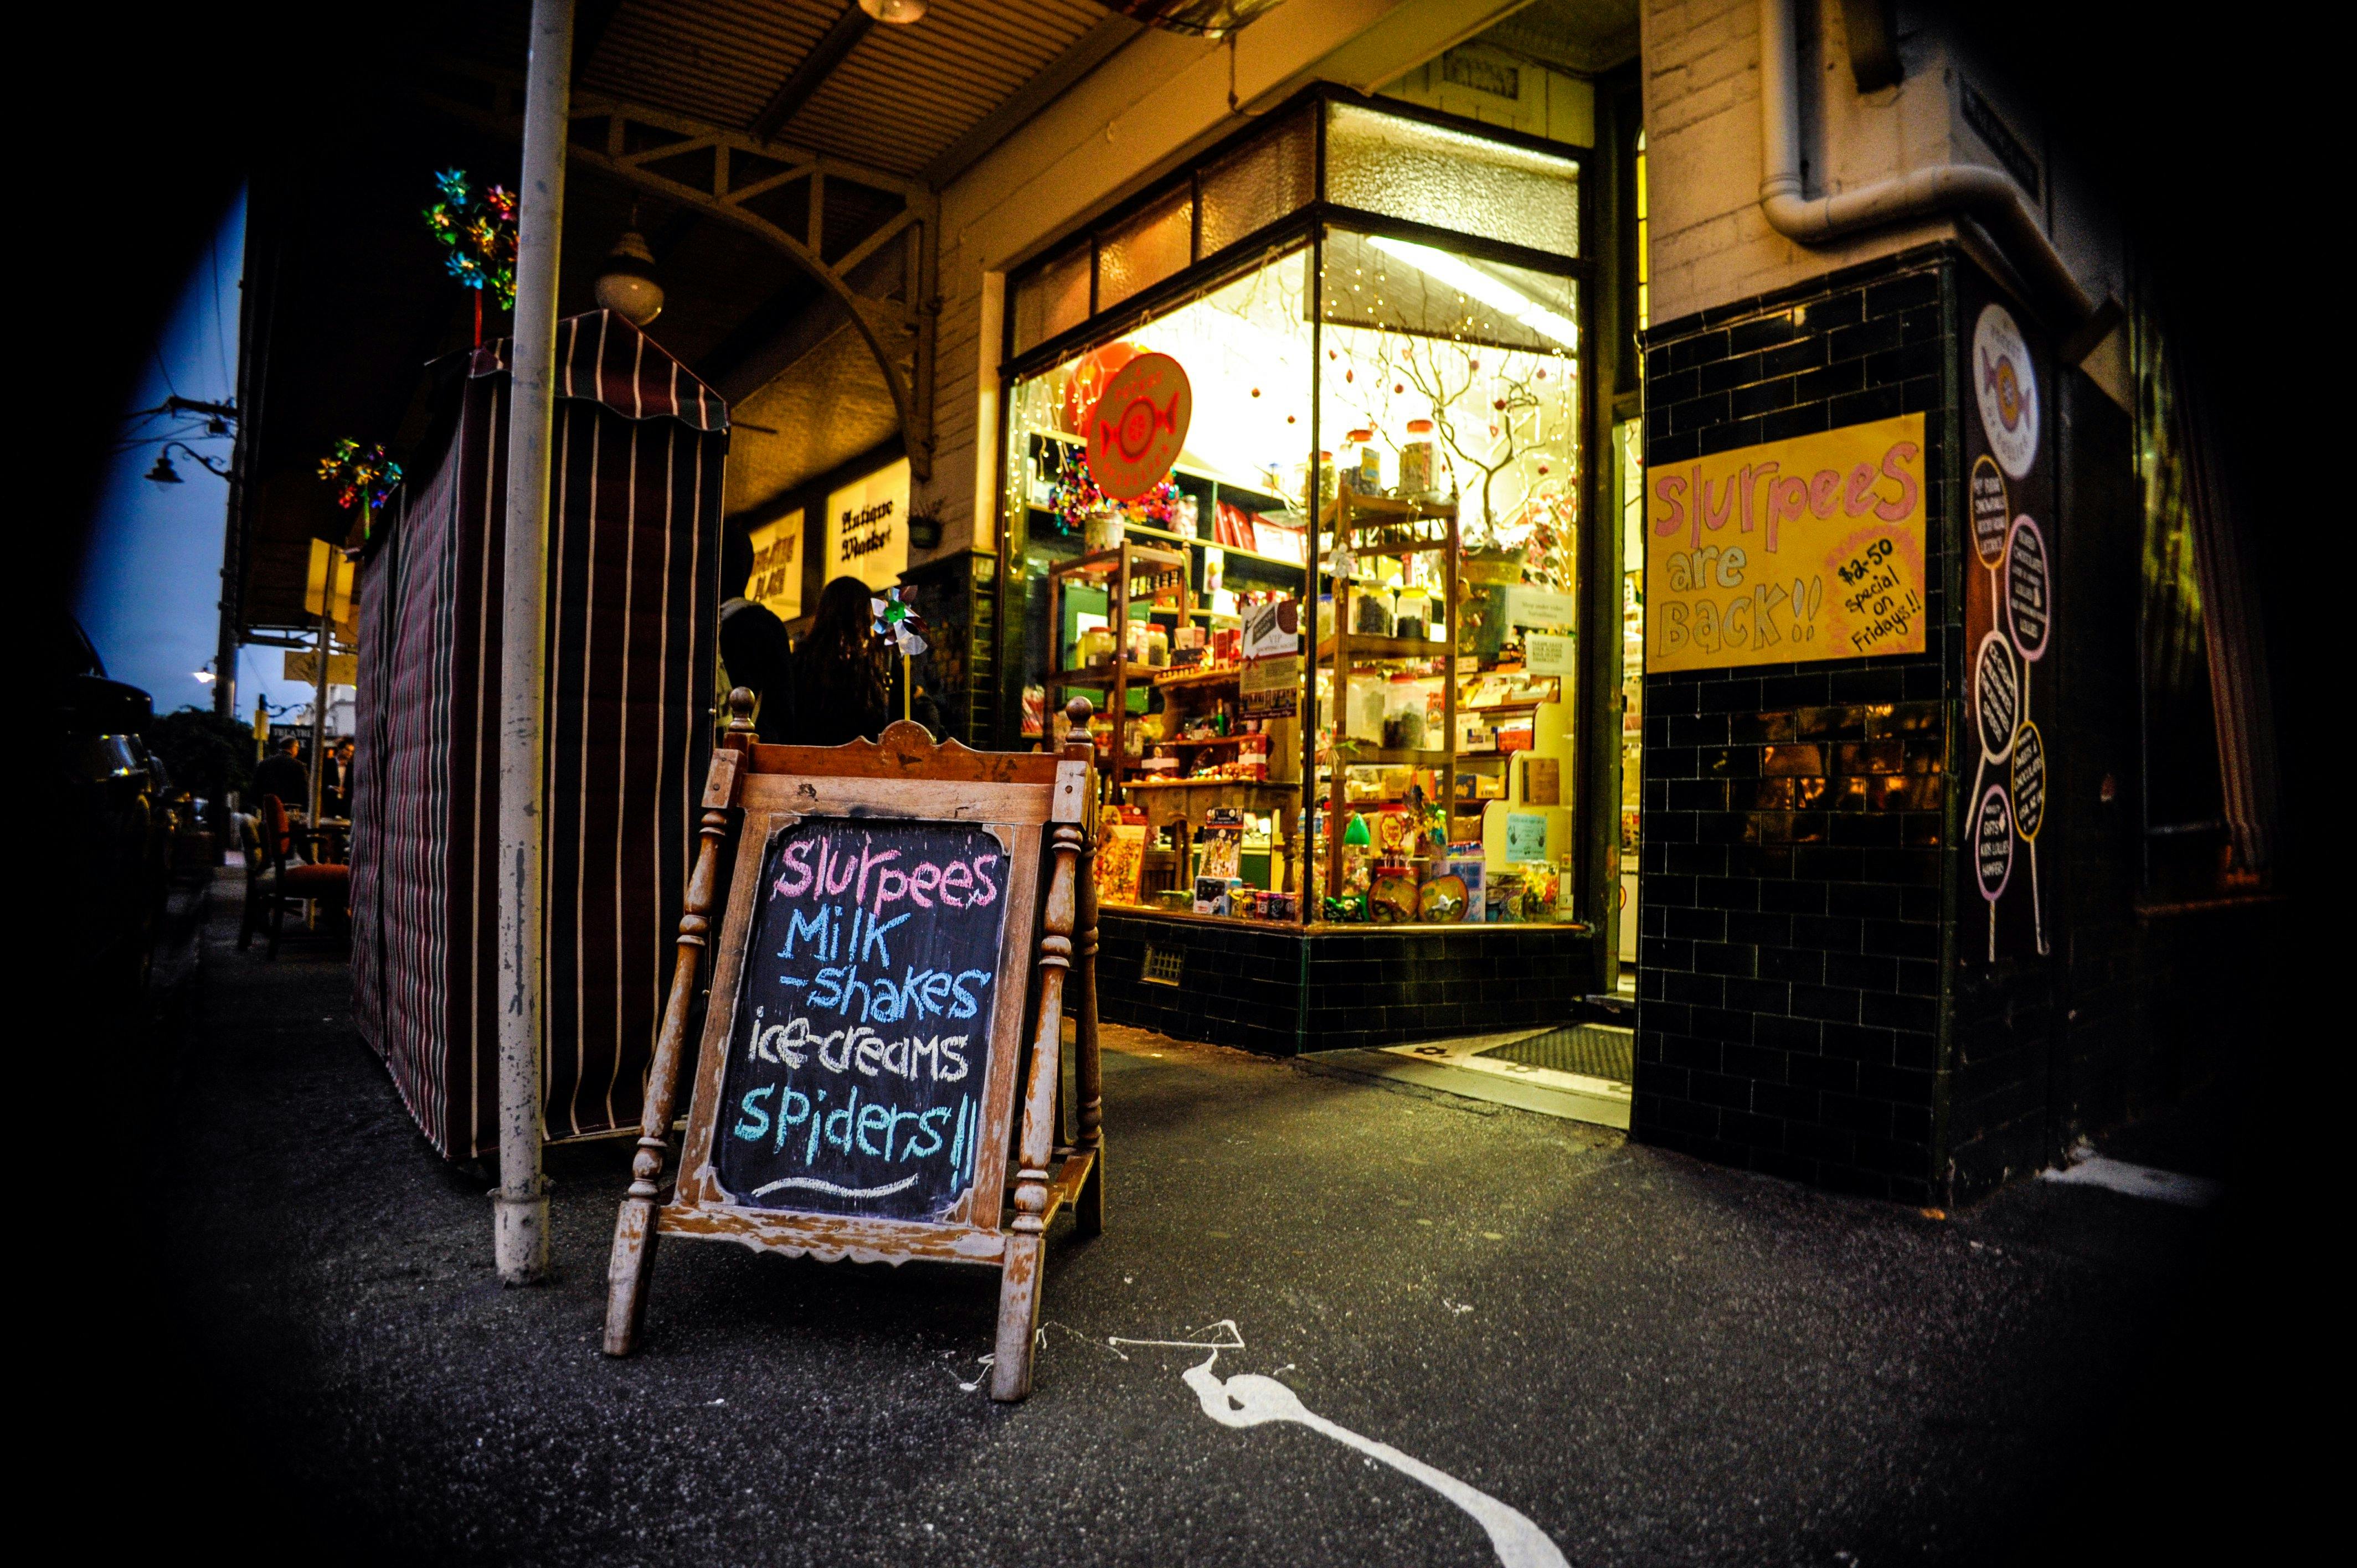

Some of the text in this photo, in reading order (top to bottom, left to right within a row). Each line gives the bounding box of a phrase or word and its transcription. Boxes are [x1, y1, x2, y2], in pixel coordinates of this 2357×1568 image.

[842, 501, 893, 533] Antique
[1667, 545, 1746, 593] are
[1851, 589, 1922, 652] Fridays!!
[1874, 596, 1894, 616] on
[777, 902, 912, 969] Milk
